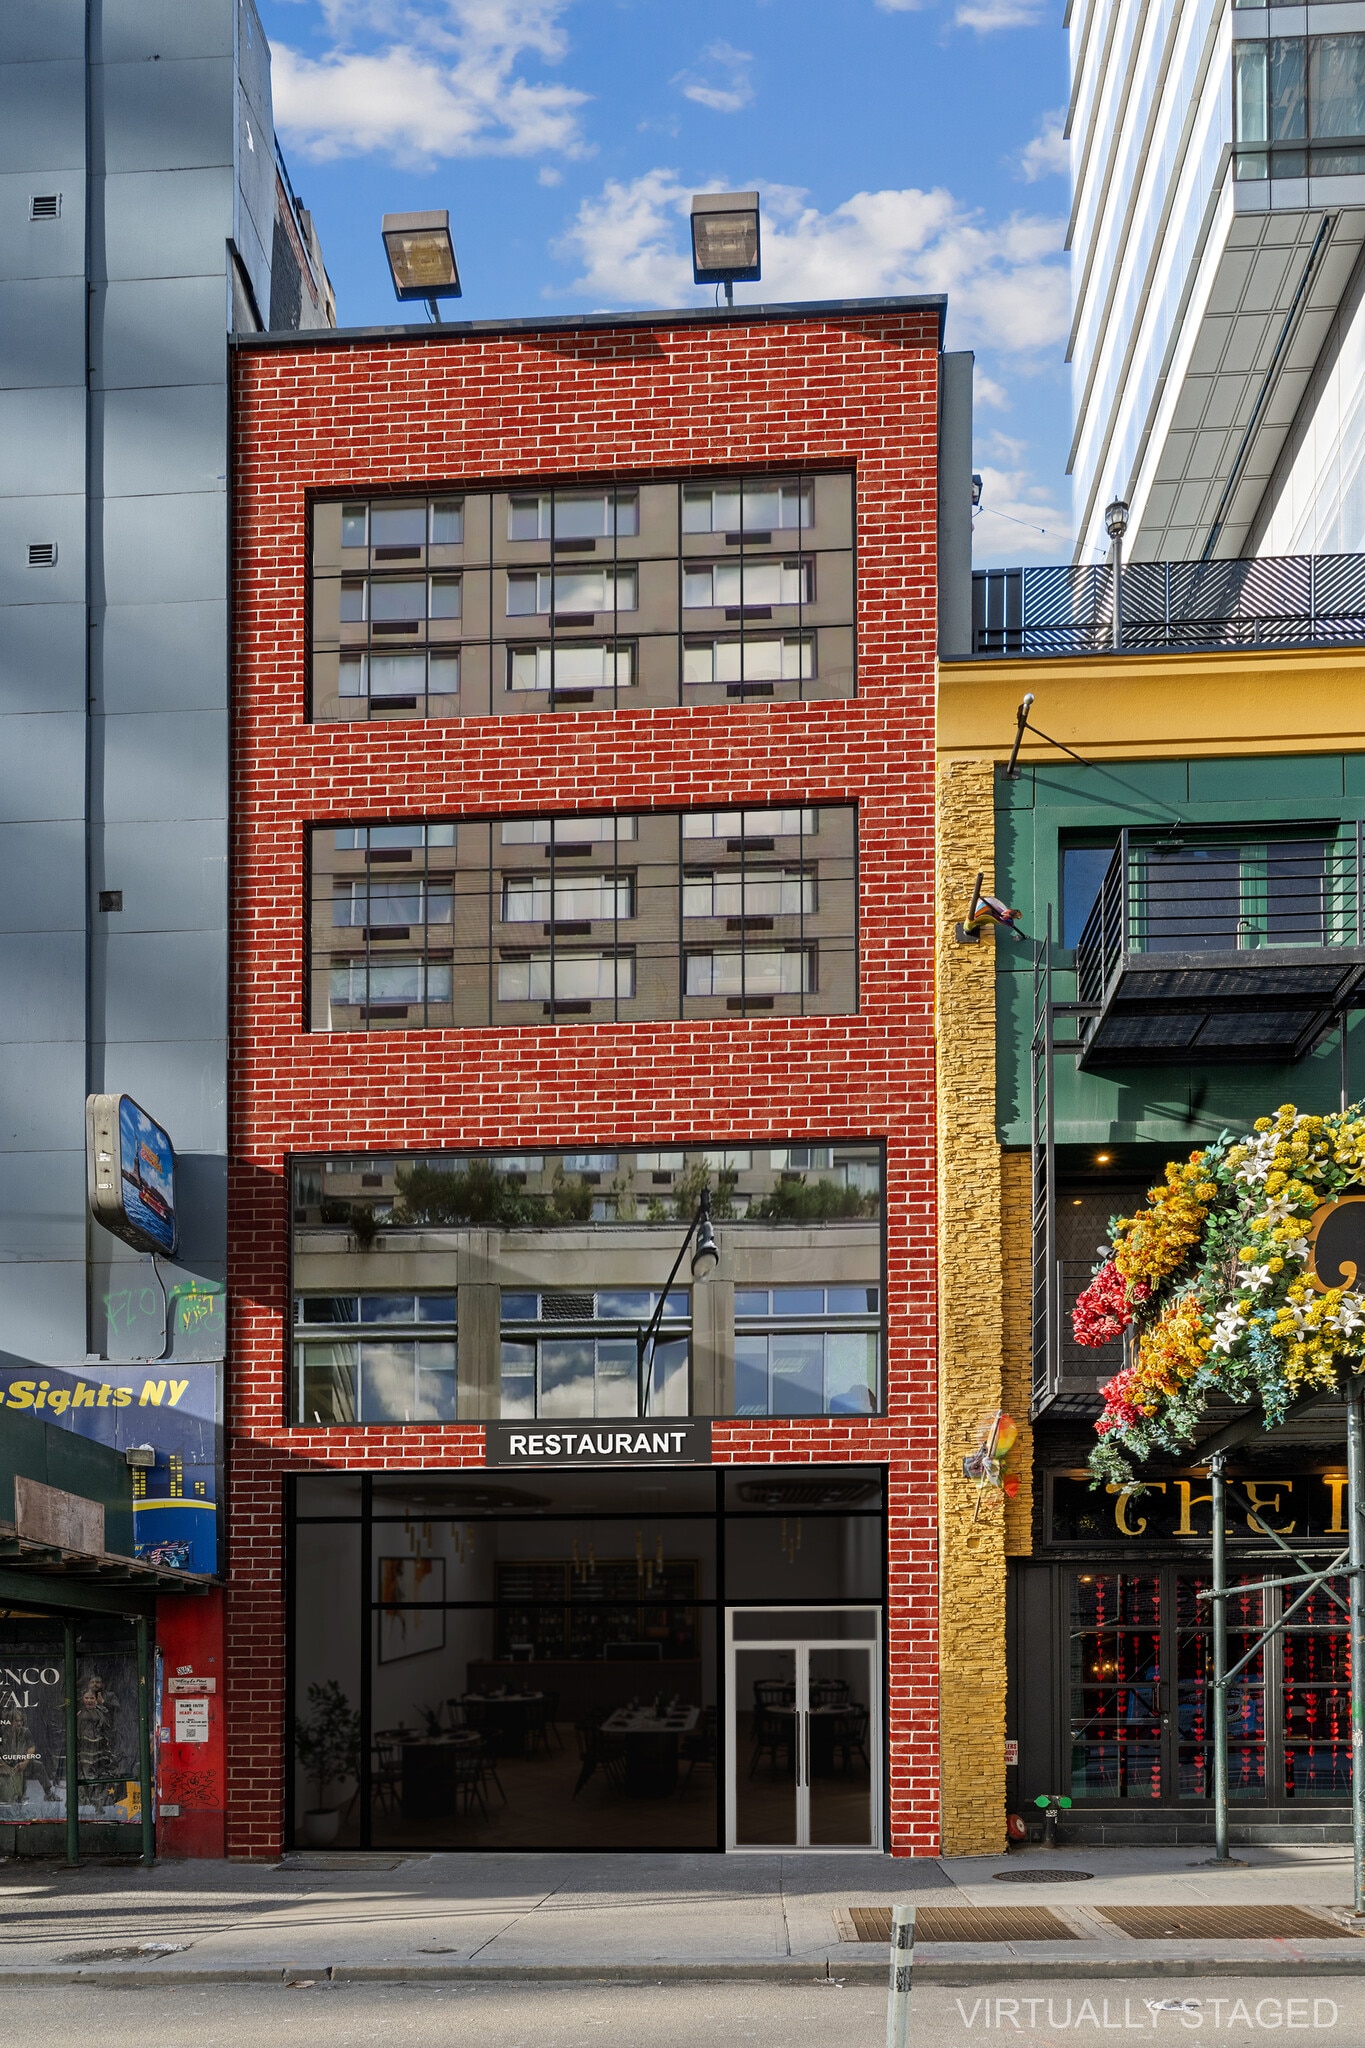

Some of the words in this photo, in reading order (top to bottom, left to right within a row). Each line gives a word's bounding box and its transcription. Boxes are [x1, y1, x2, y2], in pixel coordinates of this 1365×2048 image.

[0, 1380, 133, 1416] Sights
[139, 1379, 190, 1407] NY
[509, 1432, 687, 1456] RESTAURANT
